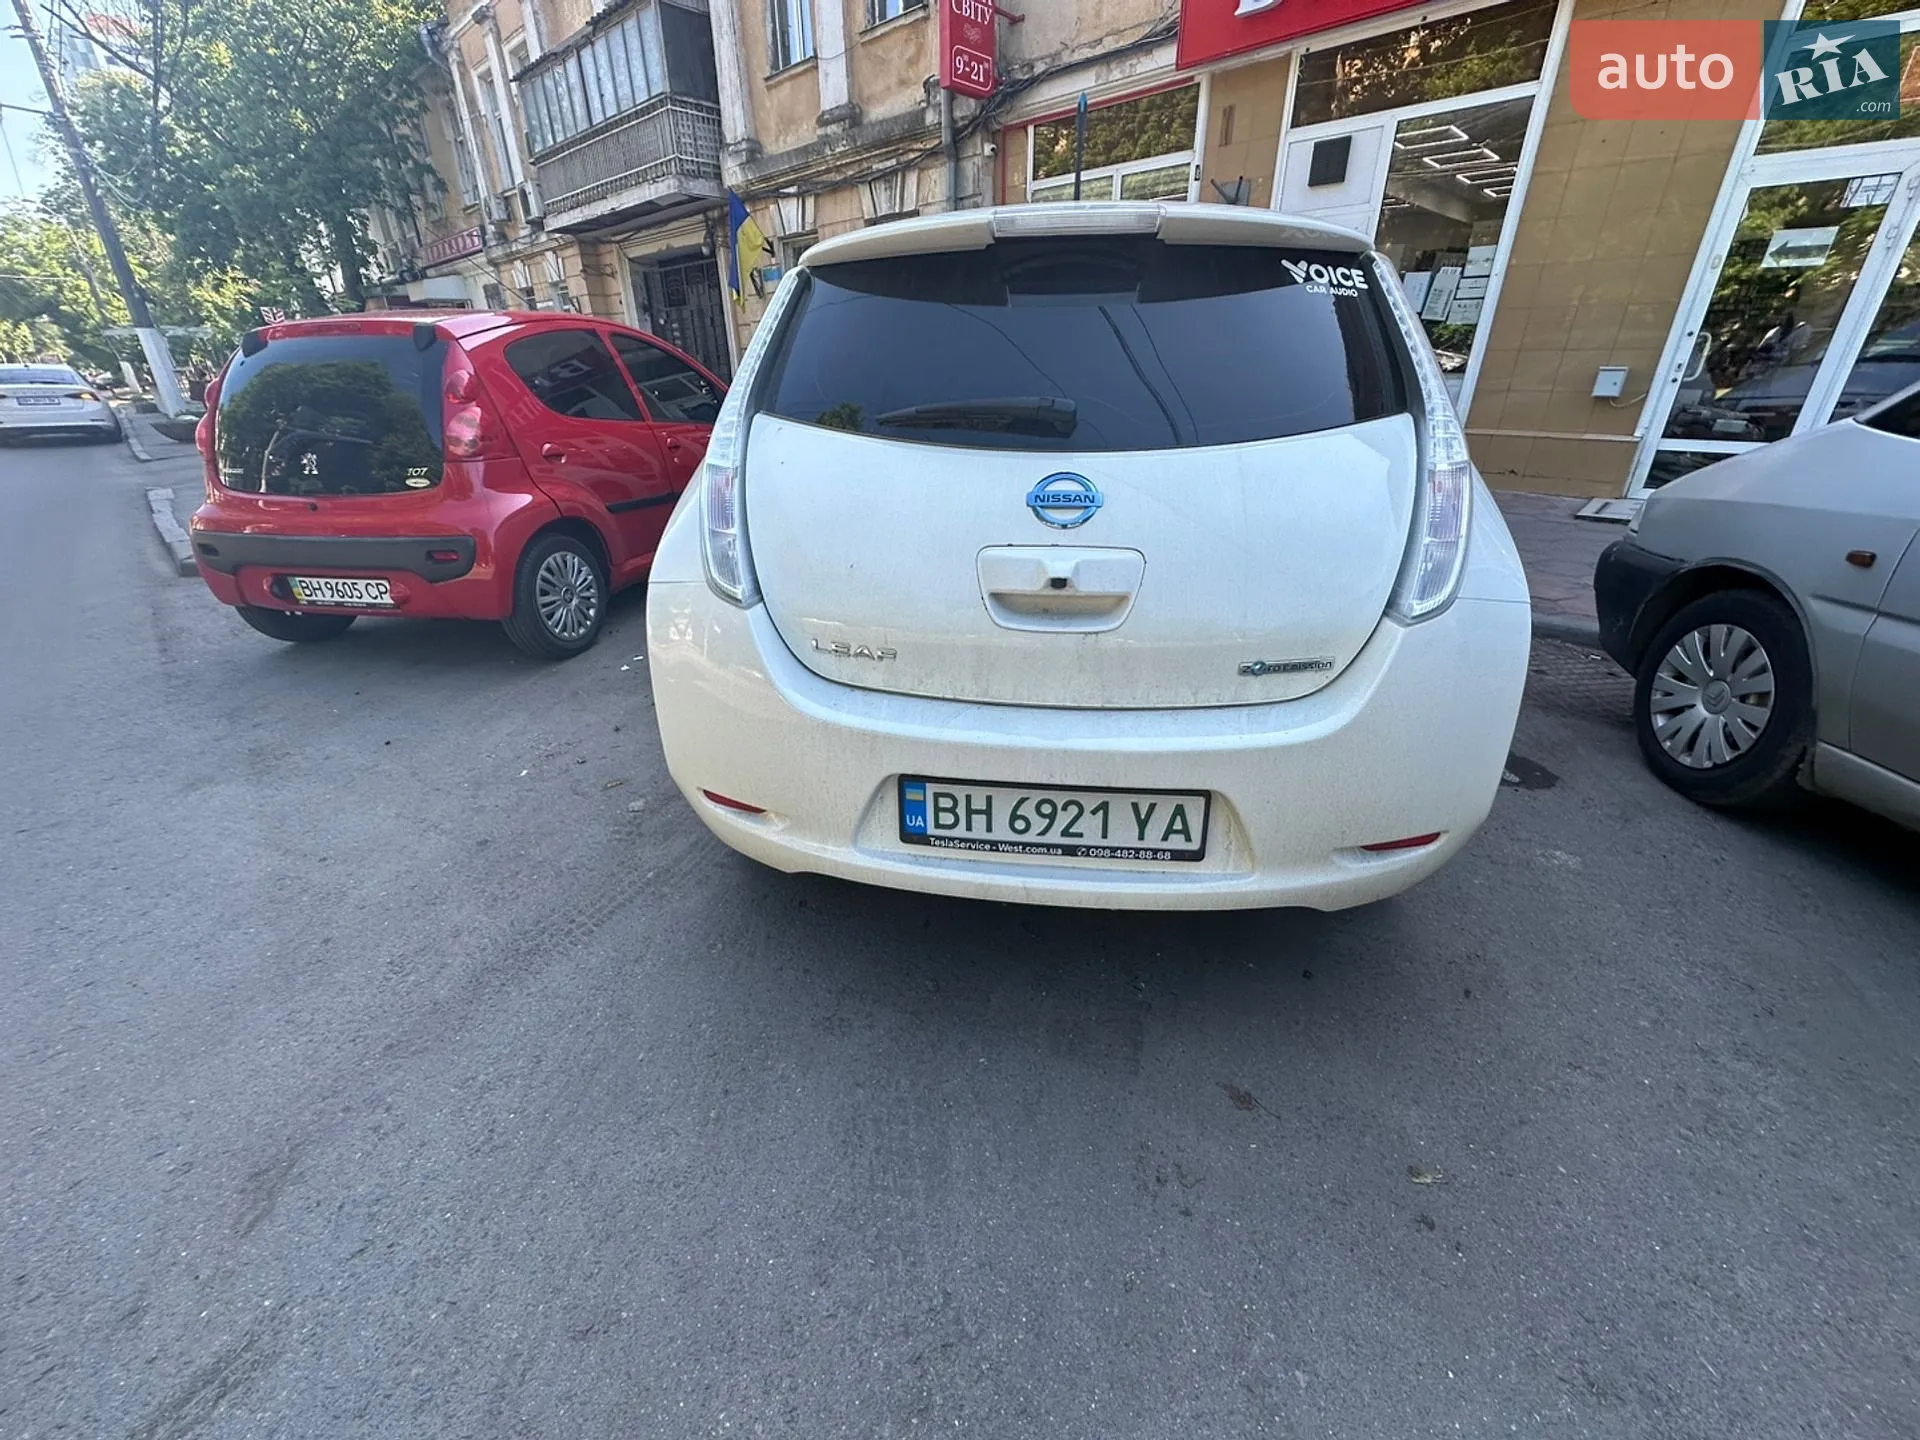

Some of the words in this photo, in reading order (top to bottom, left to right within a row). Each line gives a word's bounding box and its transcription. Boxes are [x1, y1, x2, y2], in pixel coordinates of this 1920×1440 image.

[1280, 259, 1369, 289] VOICE
[1305, 285, 1327, 295] CAR
[1329, 286, 1358, 297] AUDIO
[407, 467, 428, 476] 107
[1034, 494, 1095, 504] NISSAN
[298, 580, 325, 598] BH
[324, 581, 363, 600] 9605
[365, 582, 388, 600] CP
[906, 814, 924, 828] UA
[933, 791, 993, 833] BH
[1008, 796, 1110, 840] 6921
[1130, 801, 1193, 843] YA
